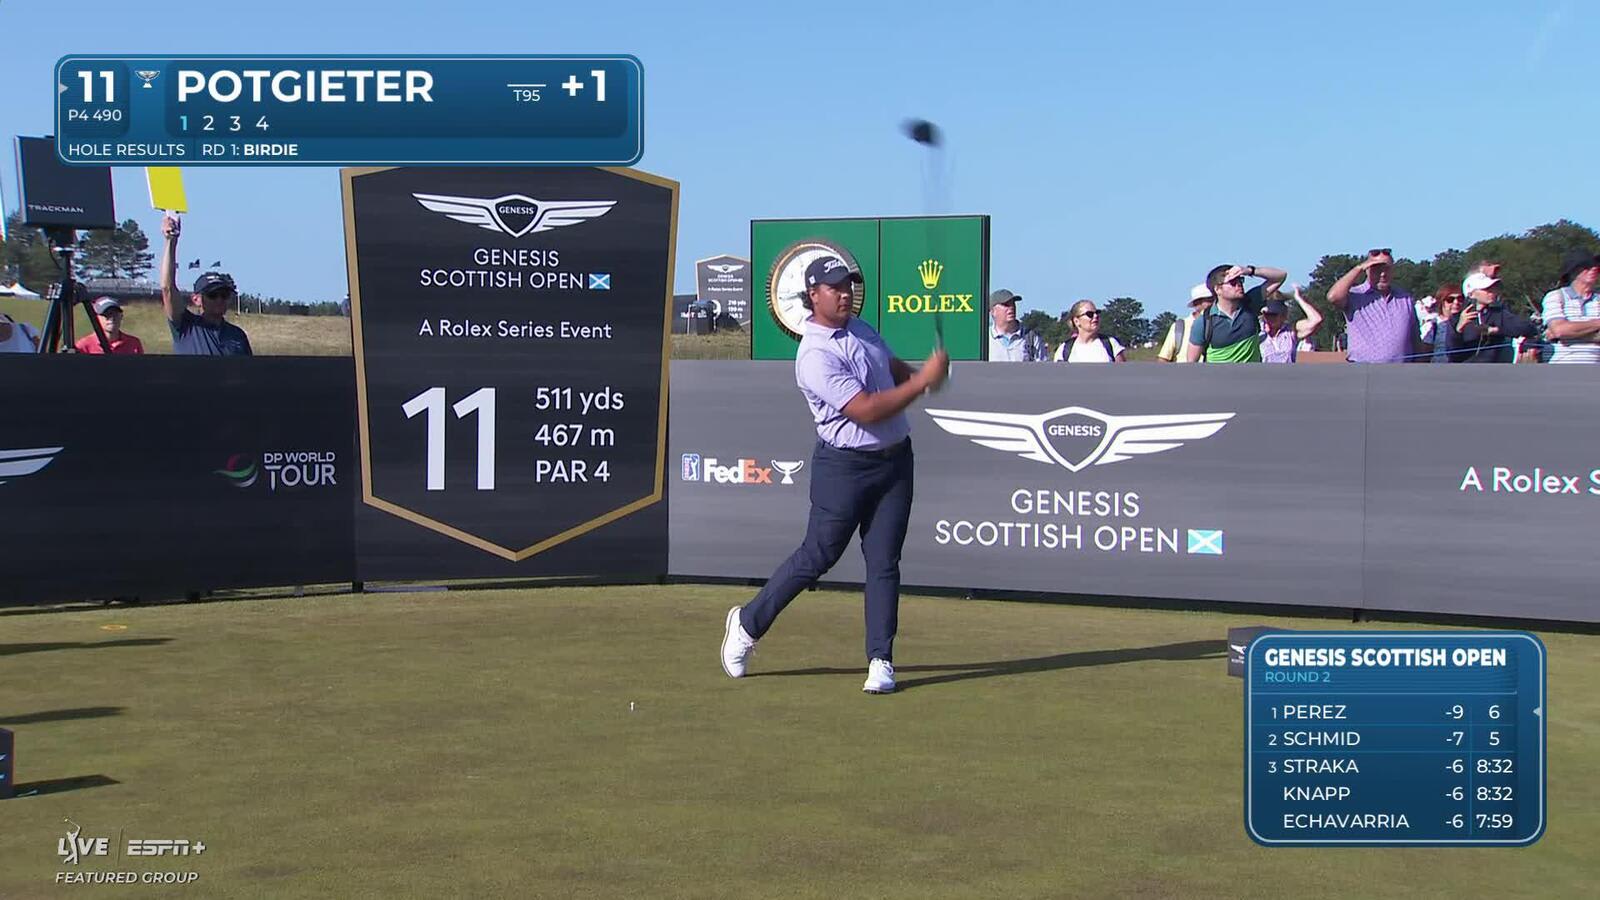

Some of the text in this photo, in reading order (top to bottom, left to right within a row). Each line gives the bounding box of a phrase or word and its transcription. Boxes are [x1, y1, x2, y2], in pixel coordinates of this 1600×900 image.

[28, 203, 84, 213] TRACKMAN
[498, 206, 534, 215] GENESIS
[473, 248, 560, 267] GENESIS
[419, 269, 584, 290] SCOTTISH OPEN
[887, 294, 974, 314] ROLEX
[418, 319, 613, 339] A Rolex Series Event
[535, 386, 625, 416] 511 yds
[401, 386, 497, 491] 11
[534, 423, 615, 446] 467 m
[1048, 424, 1102, 437] GENESIS
[264, 452, 336, 464] DP WORLD
[264, 464, 337, 491] TOUR
[535, 460, 611, 483] PAR 4
[703, 458, 773, 484] FedEx
[1460, 466, 1484, 491] A
[1493, 467, 1580, 494] Rolex
[1011, 489, 1140, 517] GENESIS
[934, 520, 1178, 553] SCOTTISH OPEN
